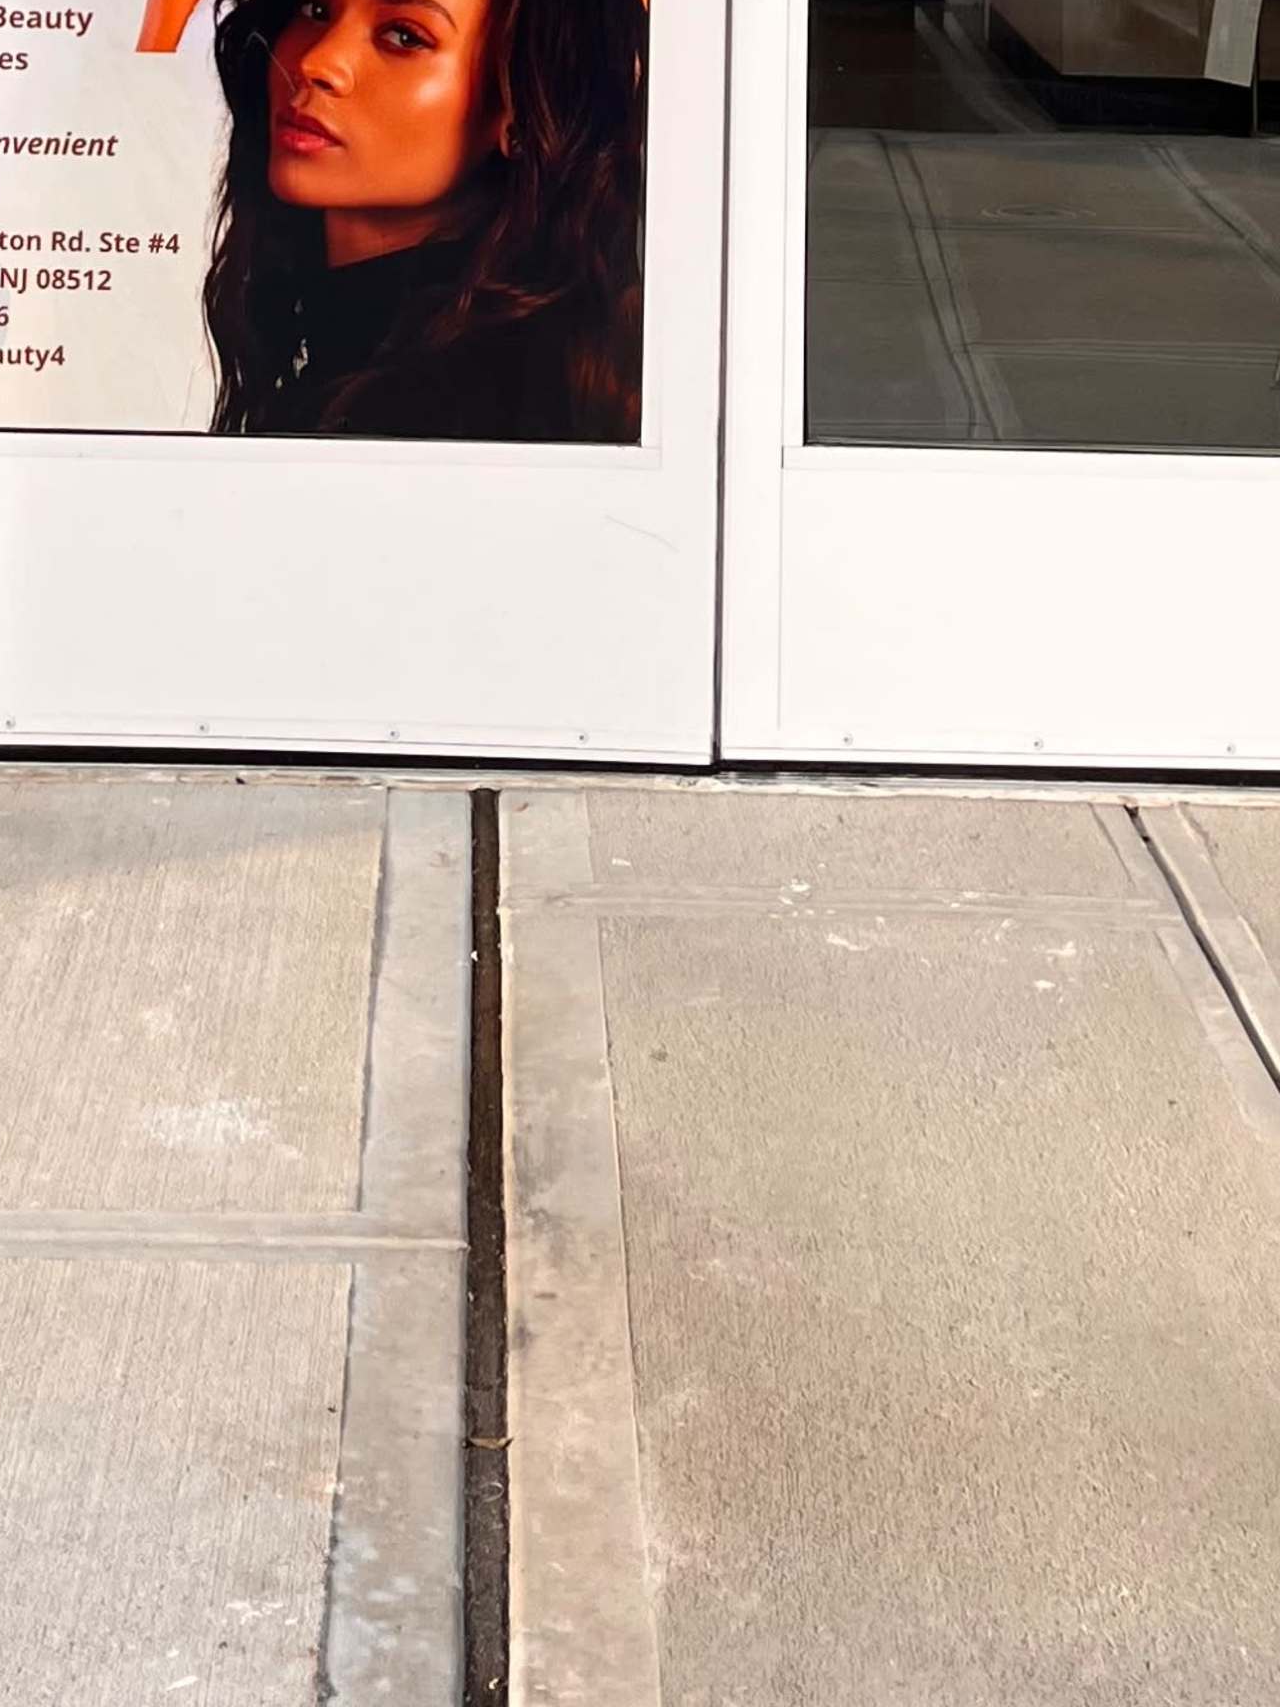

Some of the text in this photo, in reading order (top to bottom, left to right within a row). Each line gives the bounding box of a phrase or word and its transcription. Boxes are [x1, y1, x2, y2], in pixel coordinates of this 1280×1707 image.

[51, 230, 91, 253] Rd.
[100, 231, 140, 254] Ste
[148, 233, 180, 255] #4
[0, 269, 28, 294] NJ
[36, 269, 112, 291] 08512
